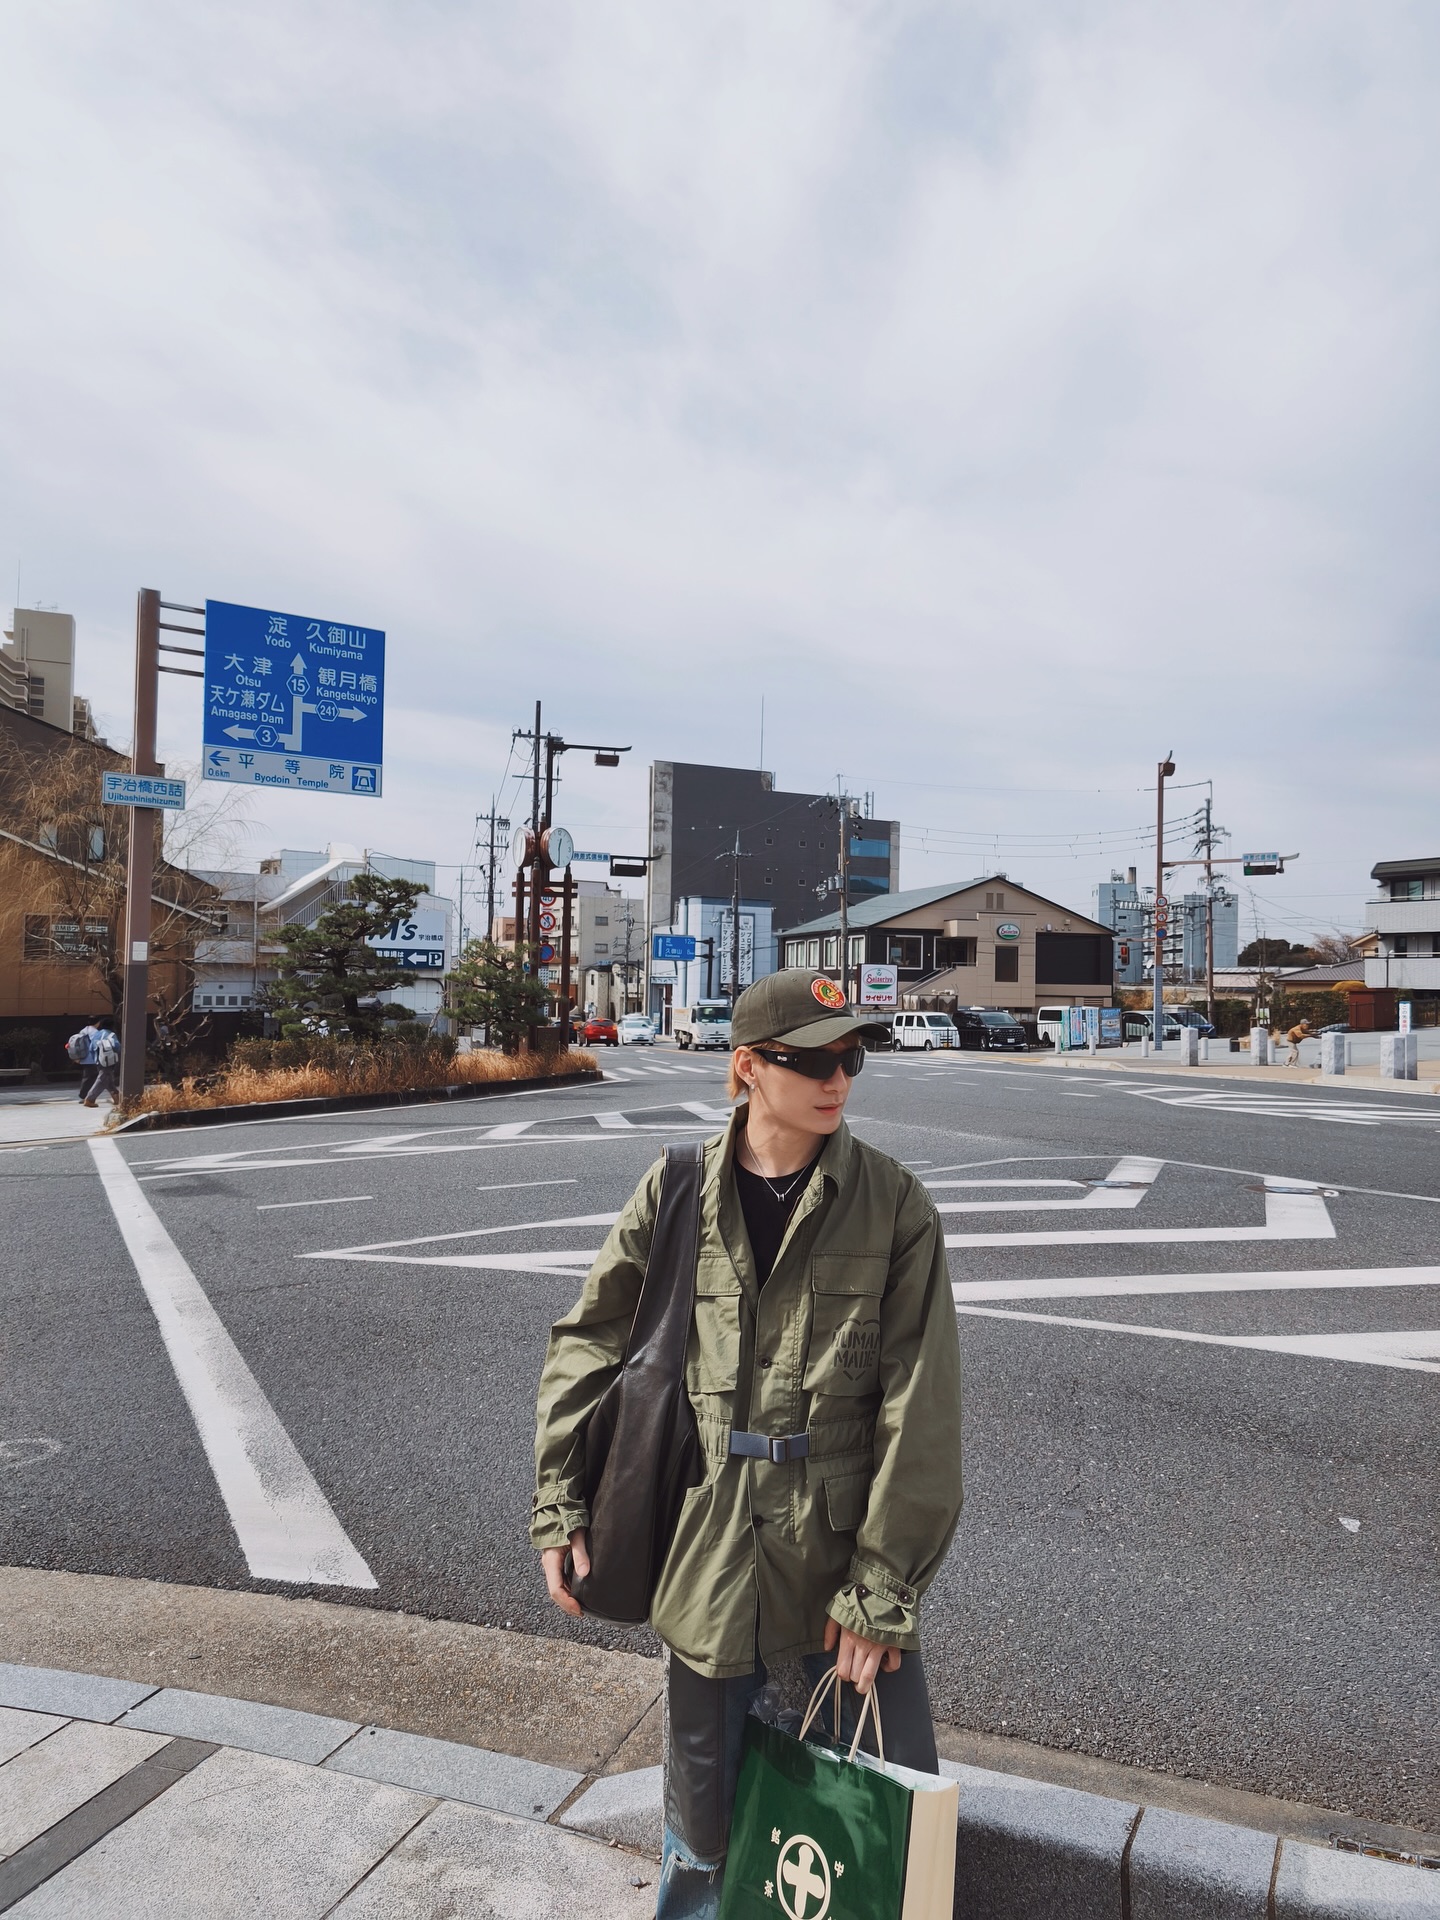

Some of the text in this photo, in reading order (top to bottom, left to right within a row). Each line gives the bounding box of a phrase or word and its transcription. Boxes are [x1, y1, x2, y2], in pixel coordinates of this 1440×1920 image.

[268, 615, 366, 649] 淀 久御山
[264, 635, 363, 661] Yodo Kumiyama
[223, 653, 273, 676] 大津
[235, 674, 261, 688] Otsu
[291, 677, 306, 692] 15
[317, 667, 378, 693] 観月橋
[316, 687, 378, 705] Kangetsukyo
[211, 706, 284, 725] Amagase Dam
[319, 704, 336, 718] 241
[262, 730, 271, 743] 3
[208, 768, 230, 779] 0.6km
[238, 753, 345, 780] 平等院
[107, 777, 183, 797] 宇治橋西詰
[254, 772, 329, 790] Byodoin Temple
[107, 792, 181, 807] Ujibashinishizume
[418, 934, 444, 942] 宇治橋店
[834, 1349, 876, 1369] MADE
